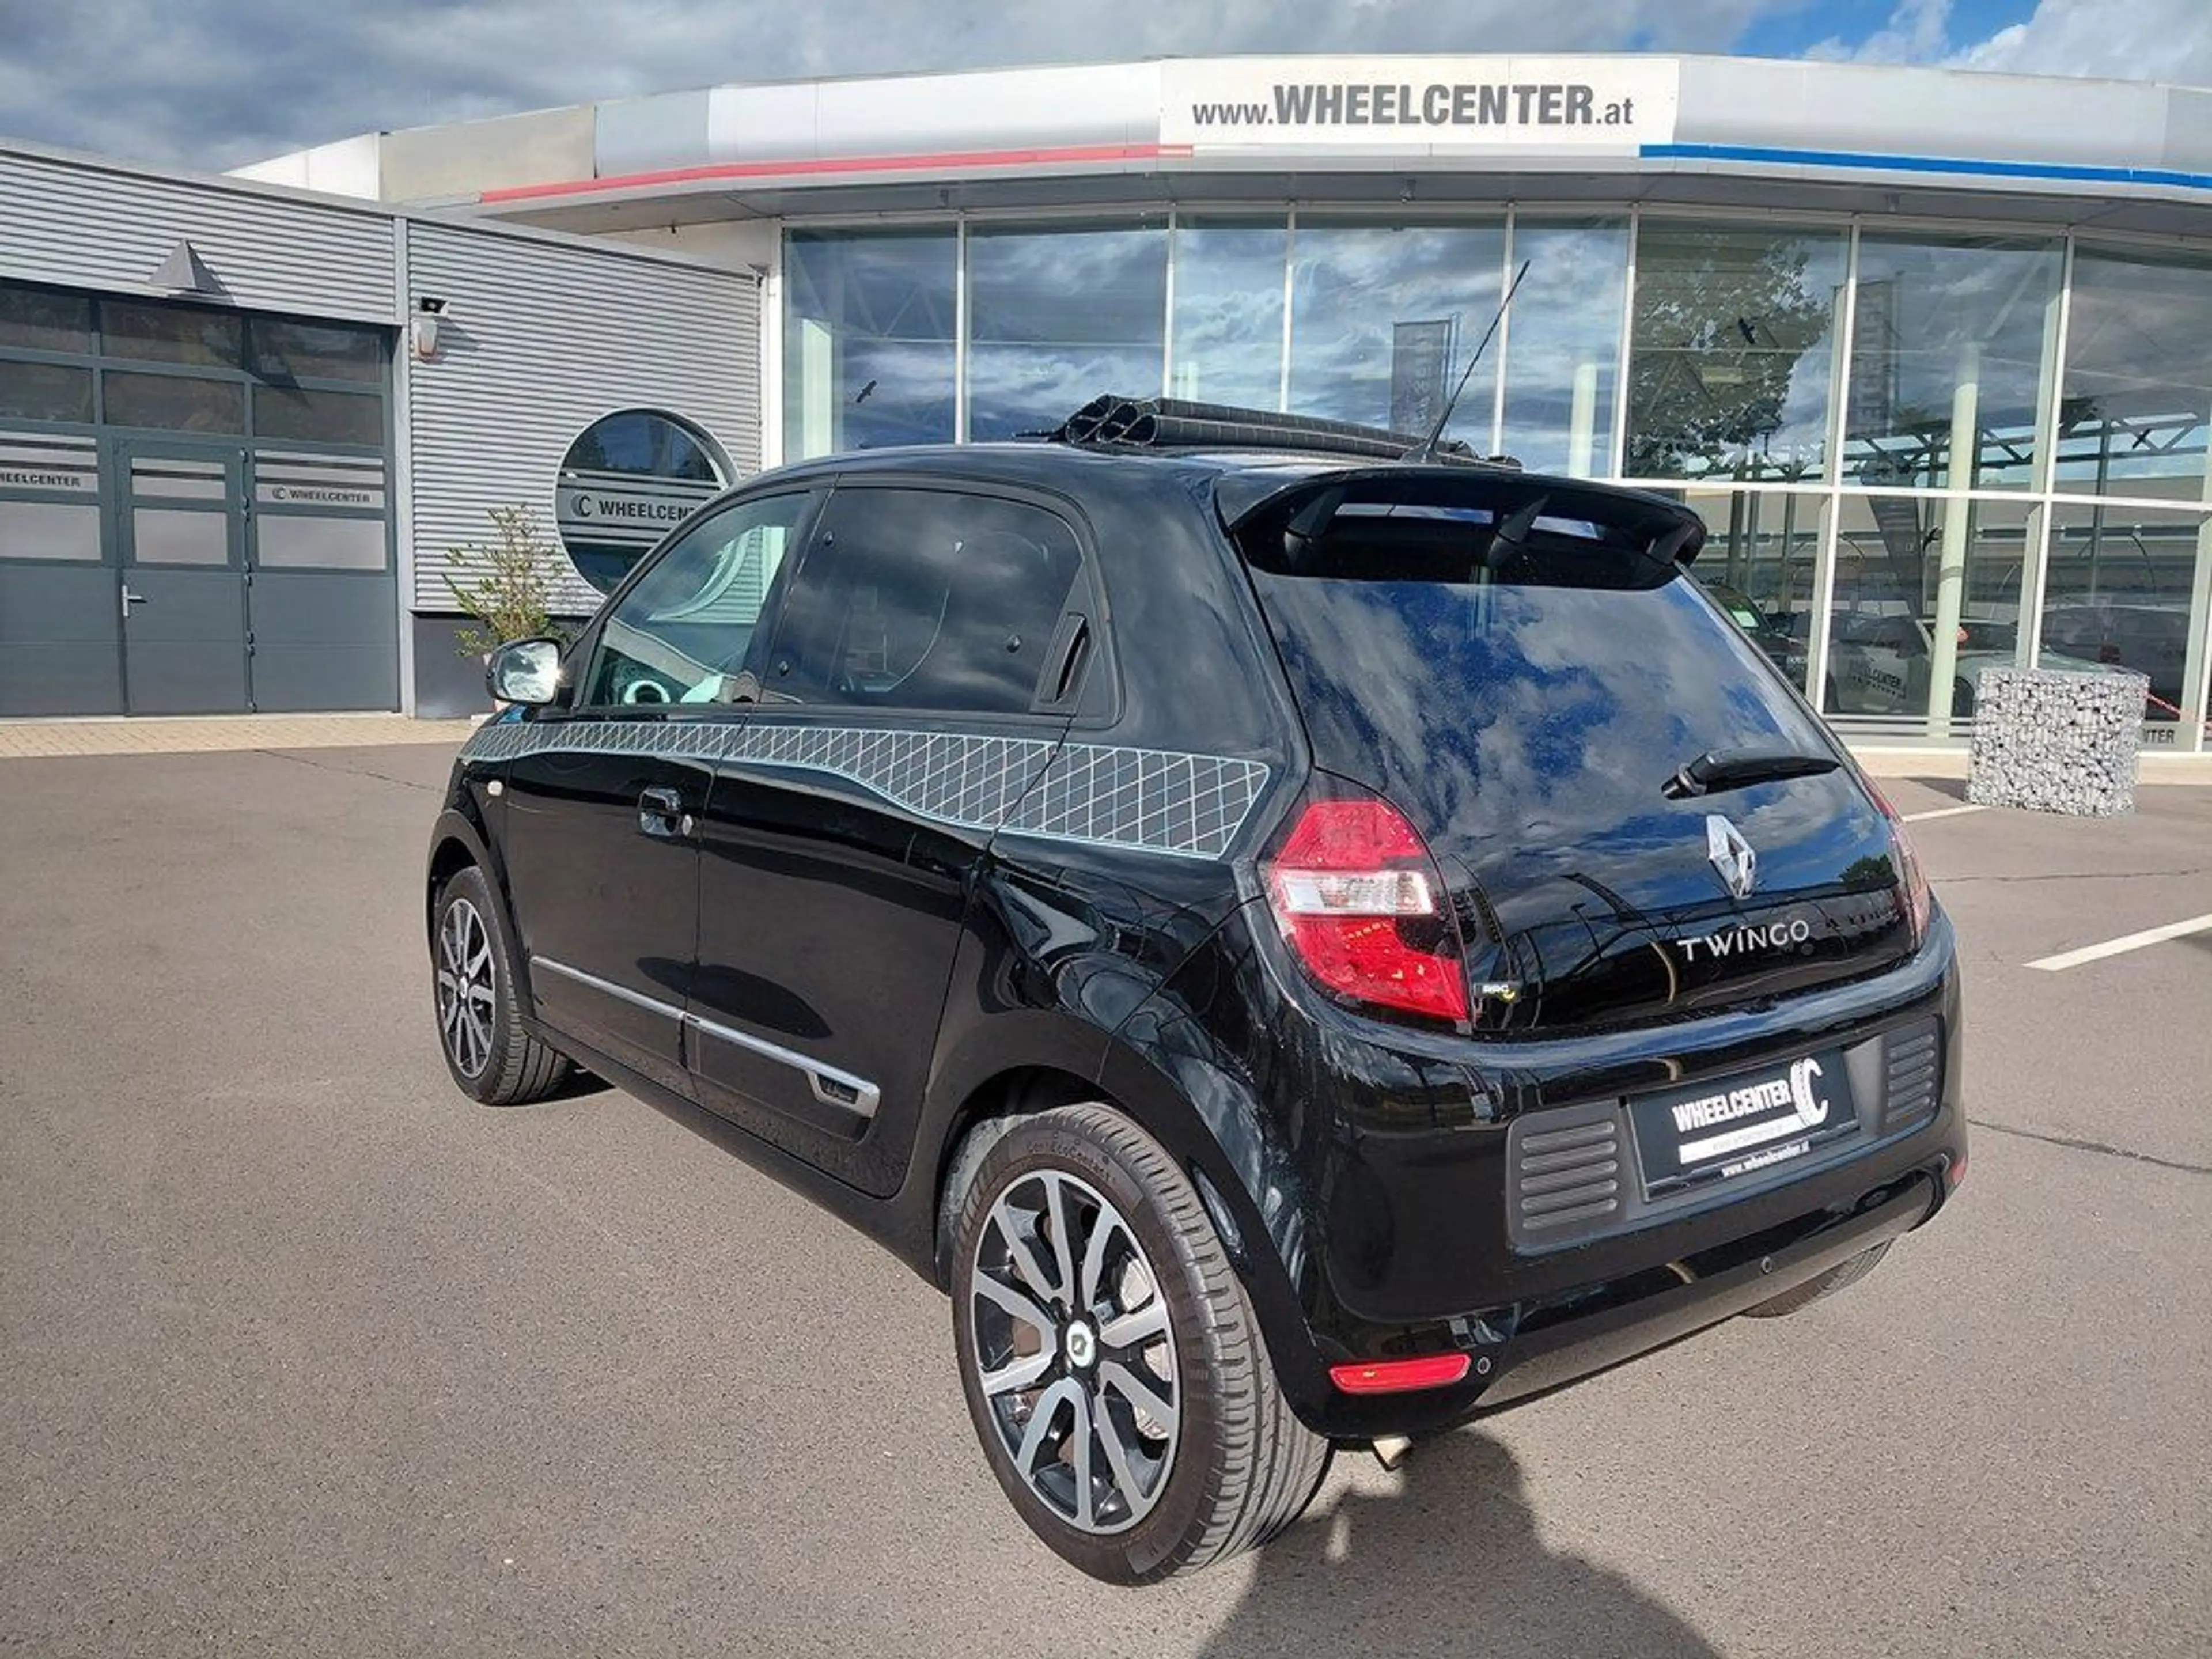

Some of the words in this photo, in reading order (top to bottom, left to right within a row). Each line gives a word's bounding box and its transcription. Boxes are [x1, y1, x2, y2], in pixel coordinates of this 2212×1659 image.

[1192, 85, 1633, 125] www.WHEELCENTER.at
[599, 501, 694, 521] WHEELCEN
[1676, 919, 1809, 961] TWINGO
[1672, 1079, 1791, 1132] WHEELCENTER
